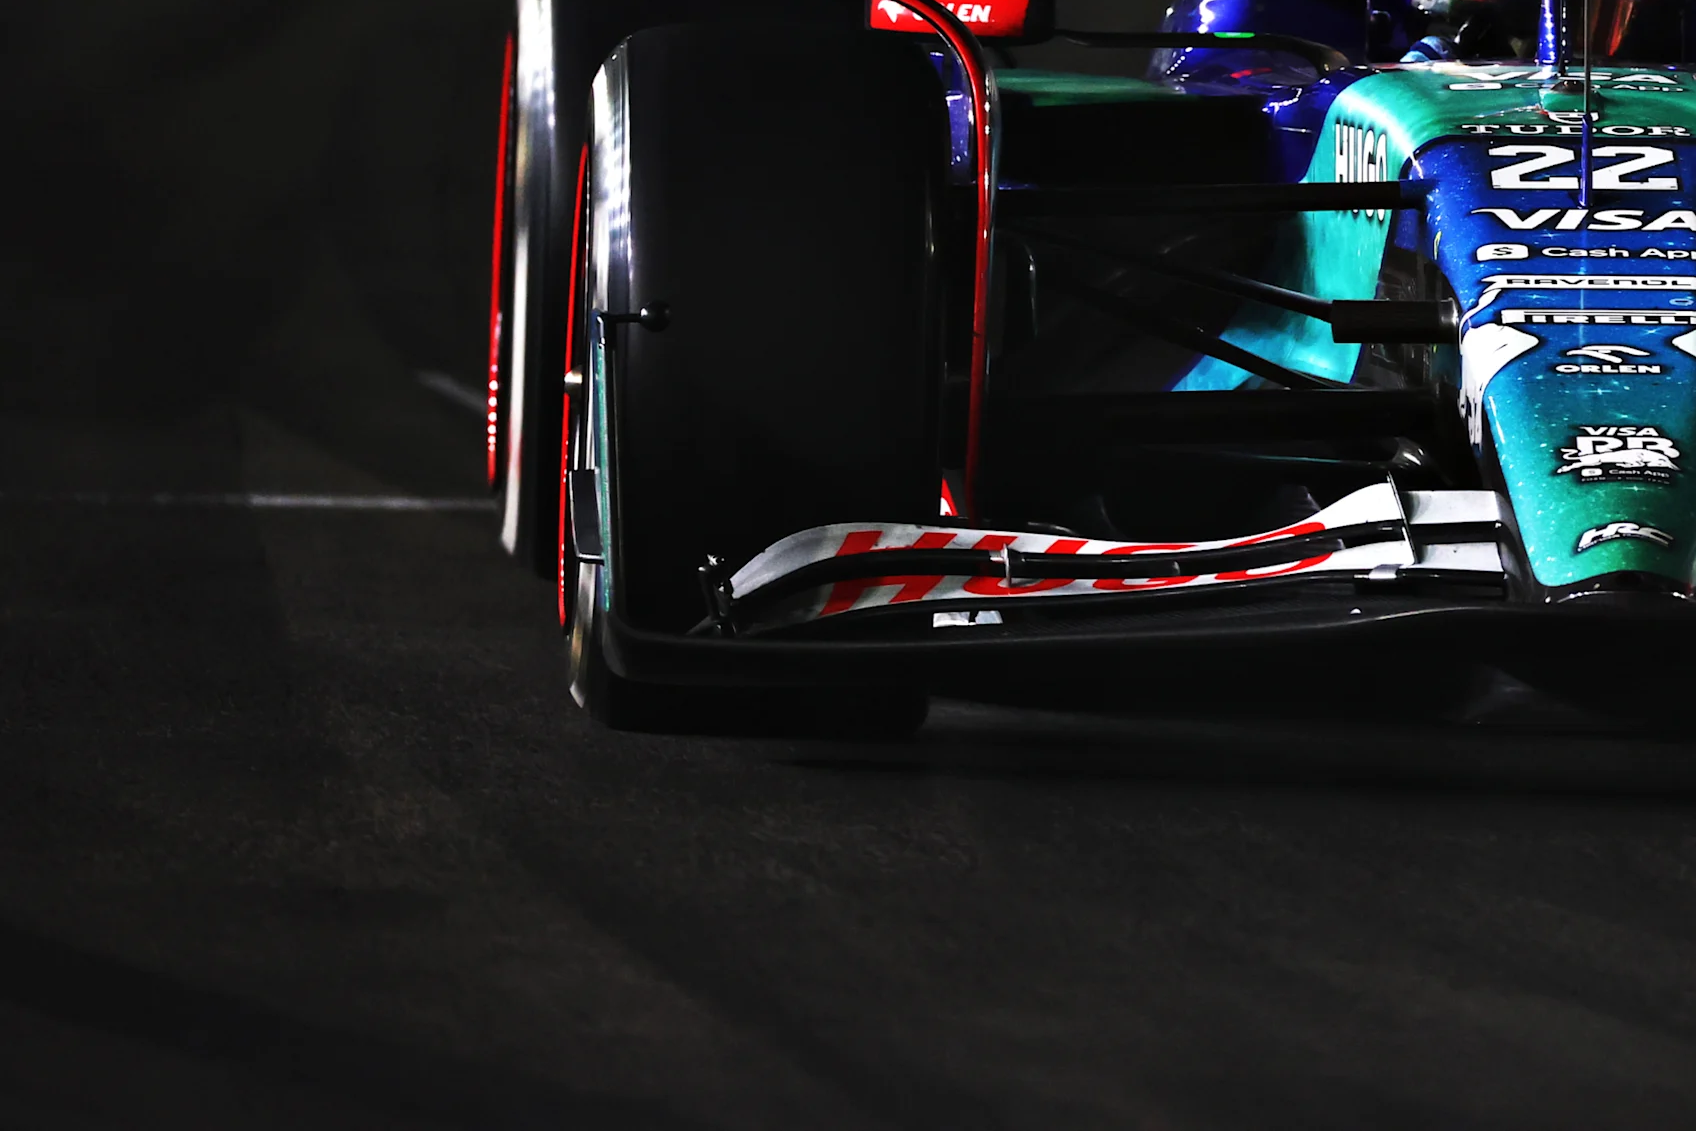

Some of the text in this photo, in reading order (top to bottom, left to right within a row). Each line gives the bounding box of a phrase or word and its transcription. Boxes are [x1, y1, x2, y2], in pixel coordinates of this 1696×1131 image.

[1461, 125, 1691, 137] TUDOR
[1488, 145, 1679, 190] 22
[1542, 246, 1630, 260] Cash
[1555, 364, 1661, 374] ORLEN
[1580, 426, 1659, 437] VISA
